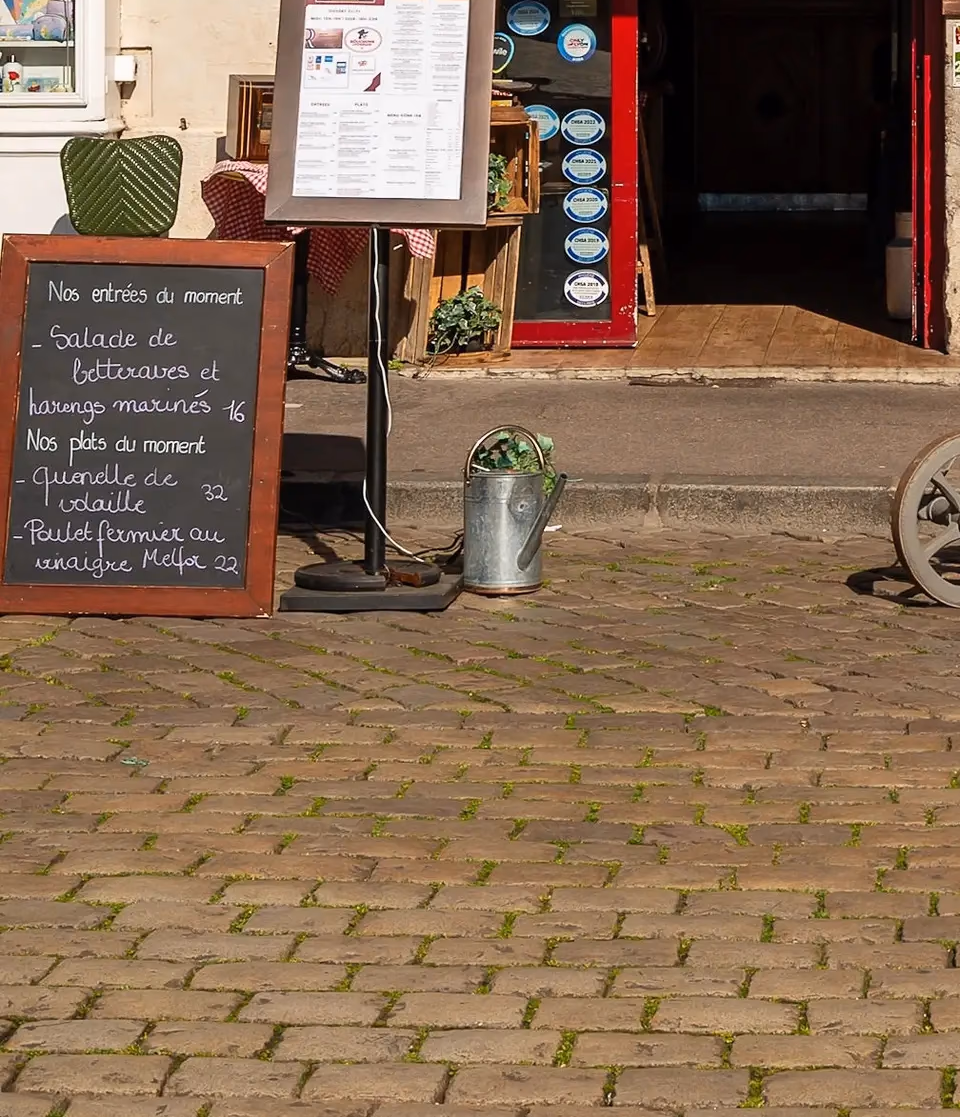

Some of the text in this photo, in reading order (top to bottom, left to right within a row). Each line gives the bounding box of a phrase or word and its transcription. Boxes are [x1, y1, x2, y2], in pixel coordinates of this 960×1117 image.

[48, 280, 244, 305] Nos entrées du moment
[50, 325, 178, 351] Salade de
[72, 357, 220, 385] betteraves et
[28, 388, 246, 425] harengs marinés 16
[26, 428, 207, 467] Nos plats du moment
[144, 467, 179, 487] de
[58, 491, 147, 514] volaille
[201, 484, 228, 502] 32
[24, 518, 226, 559] Poulet fermier au
[213, 555, 240, 575] 22
